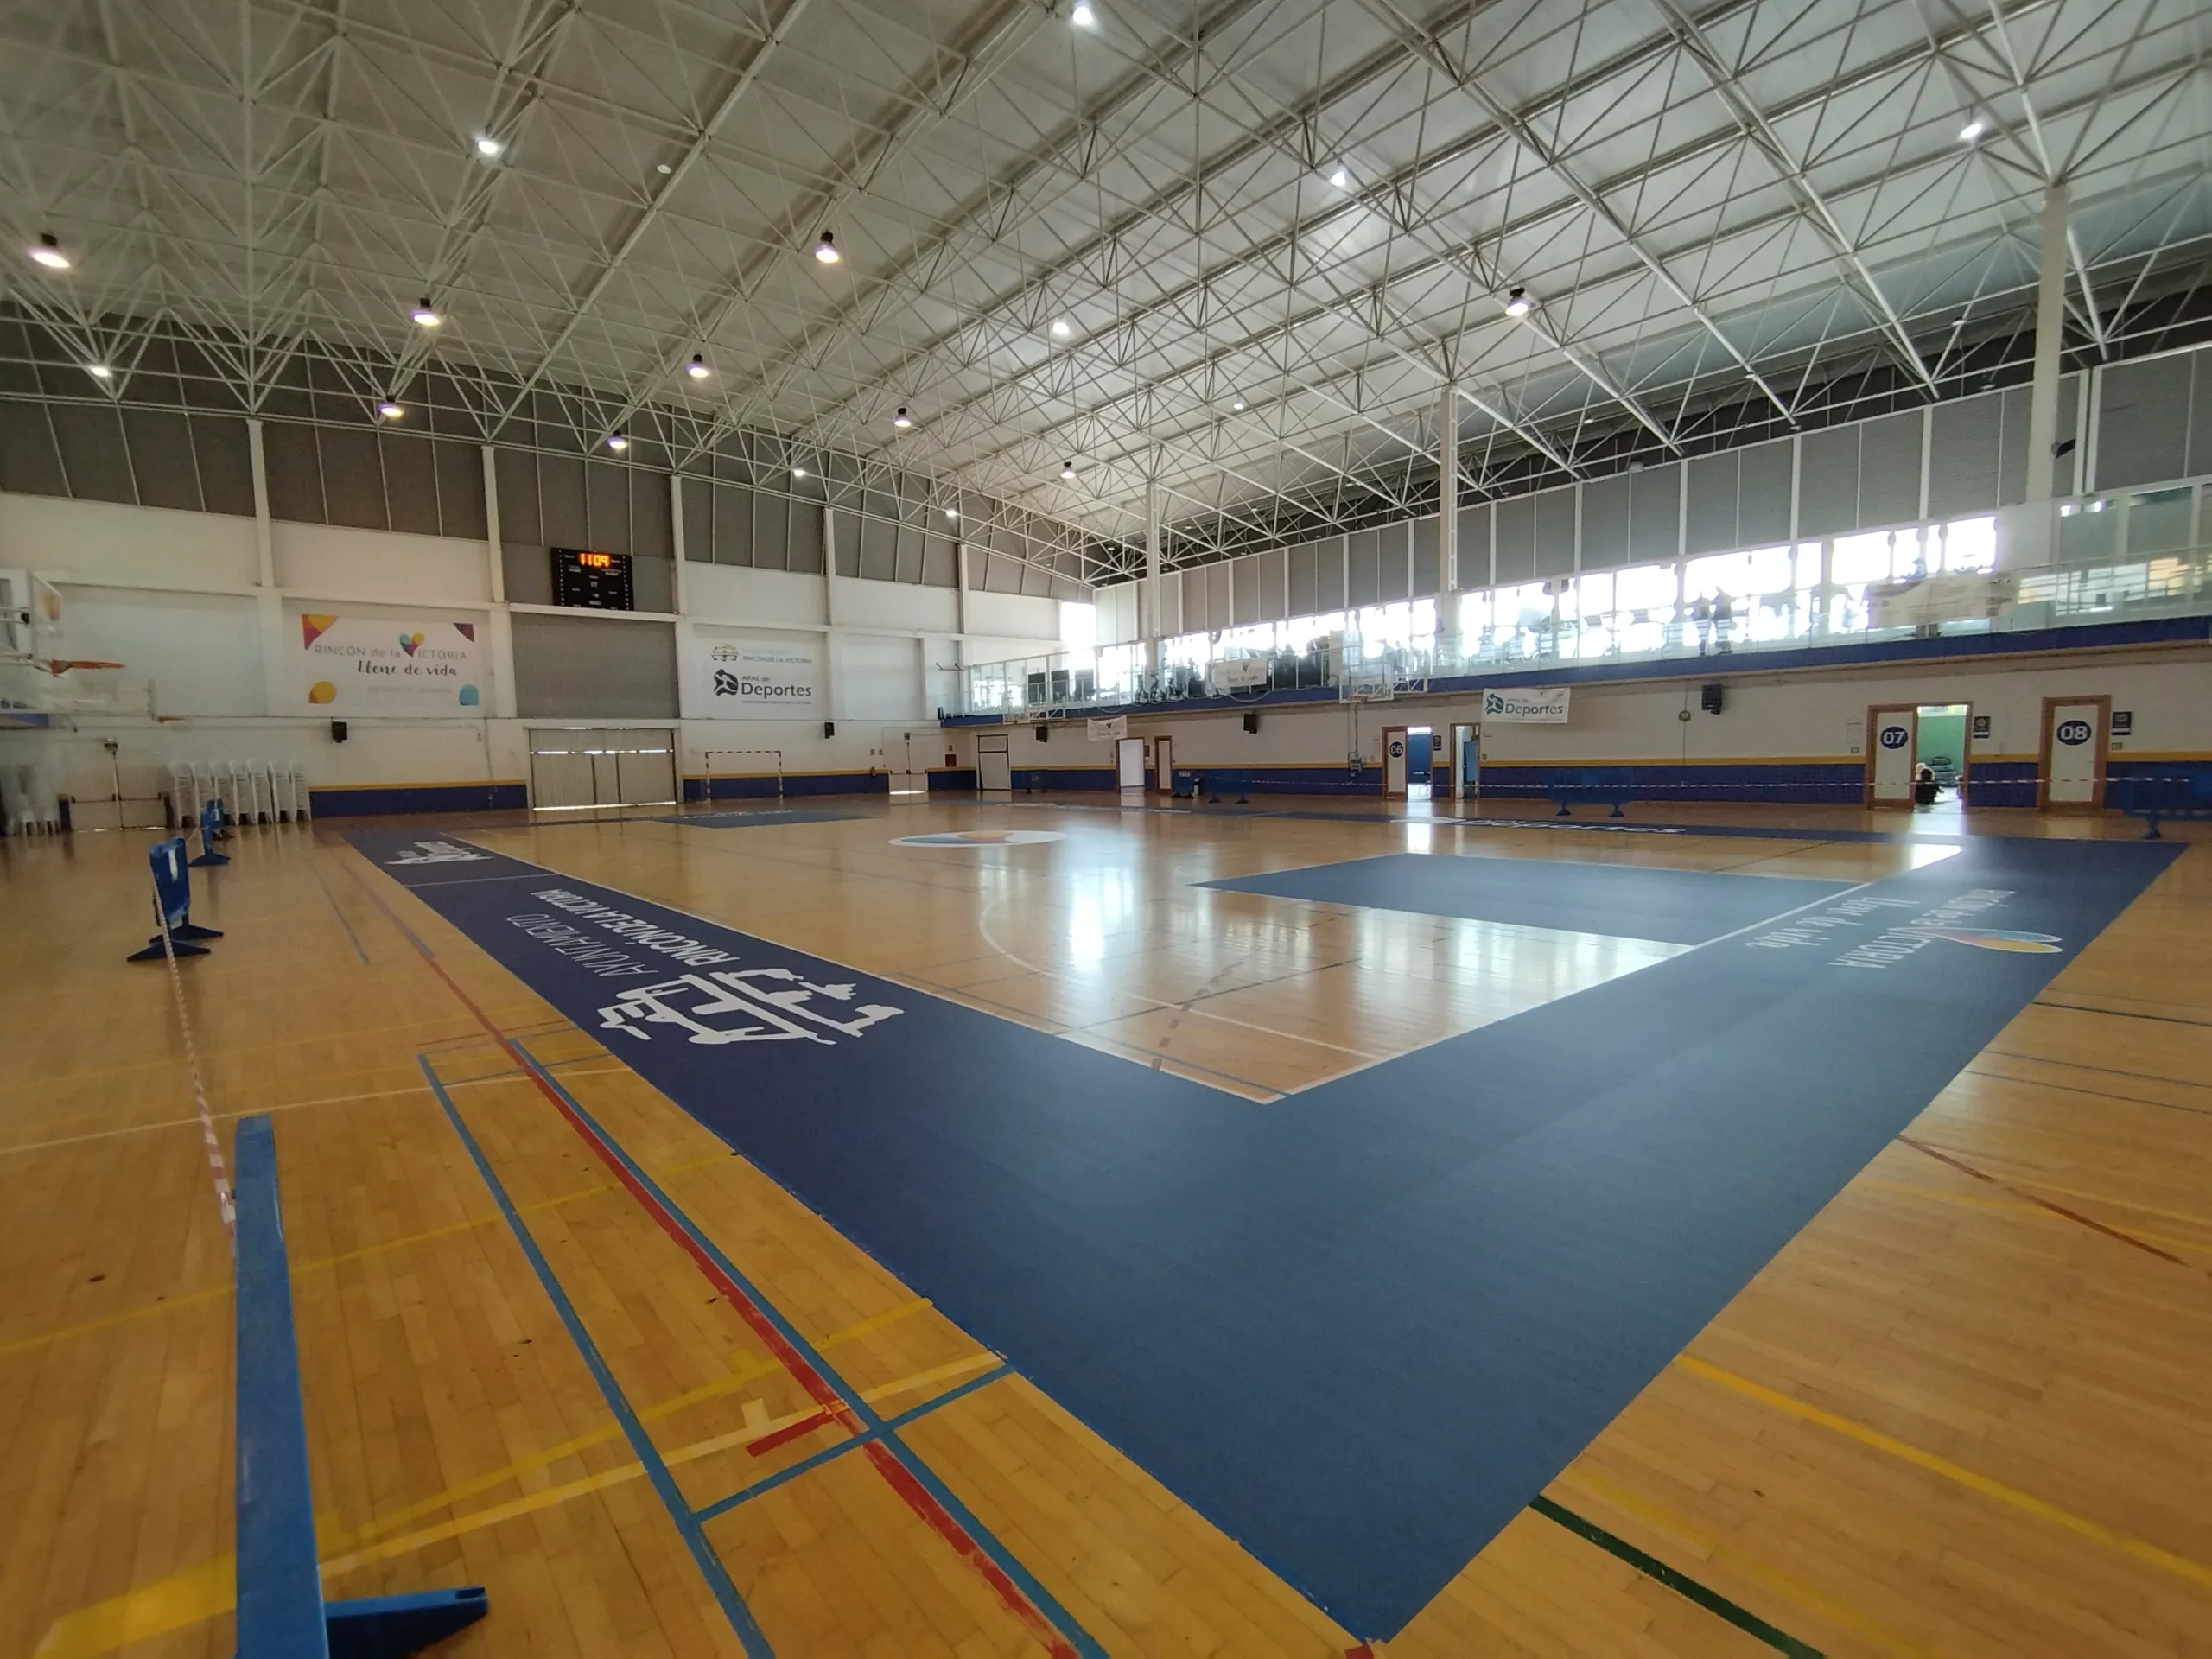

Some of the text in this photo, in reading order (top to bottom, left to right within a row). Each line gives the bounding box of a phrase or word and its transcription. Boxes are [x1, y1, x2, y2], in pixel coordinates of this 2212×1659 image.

[315, 645, 366, 657] RINCÓN
[371, 649, 385, 658] de
[391, 648, 401, 658] la
[404, 664, 422, 676] de
[426, 664, 458, 676] vida
[741, 682, 811, 699] Deportes
[1505, 703, 1564, 717] Deportes
[1883, 731, 1905, 744] 07
[2060, 726, 2088, 740] 08
[1390, 745, 1402, 754] 06
[582, 910, 635, 924] LA
[600, 919, 659, 933] DE
[622, 929, 740, 966] RINCÓN
